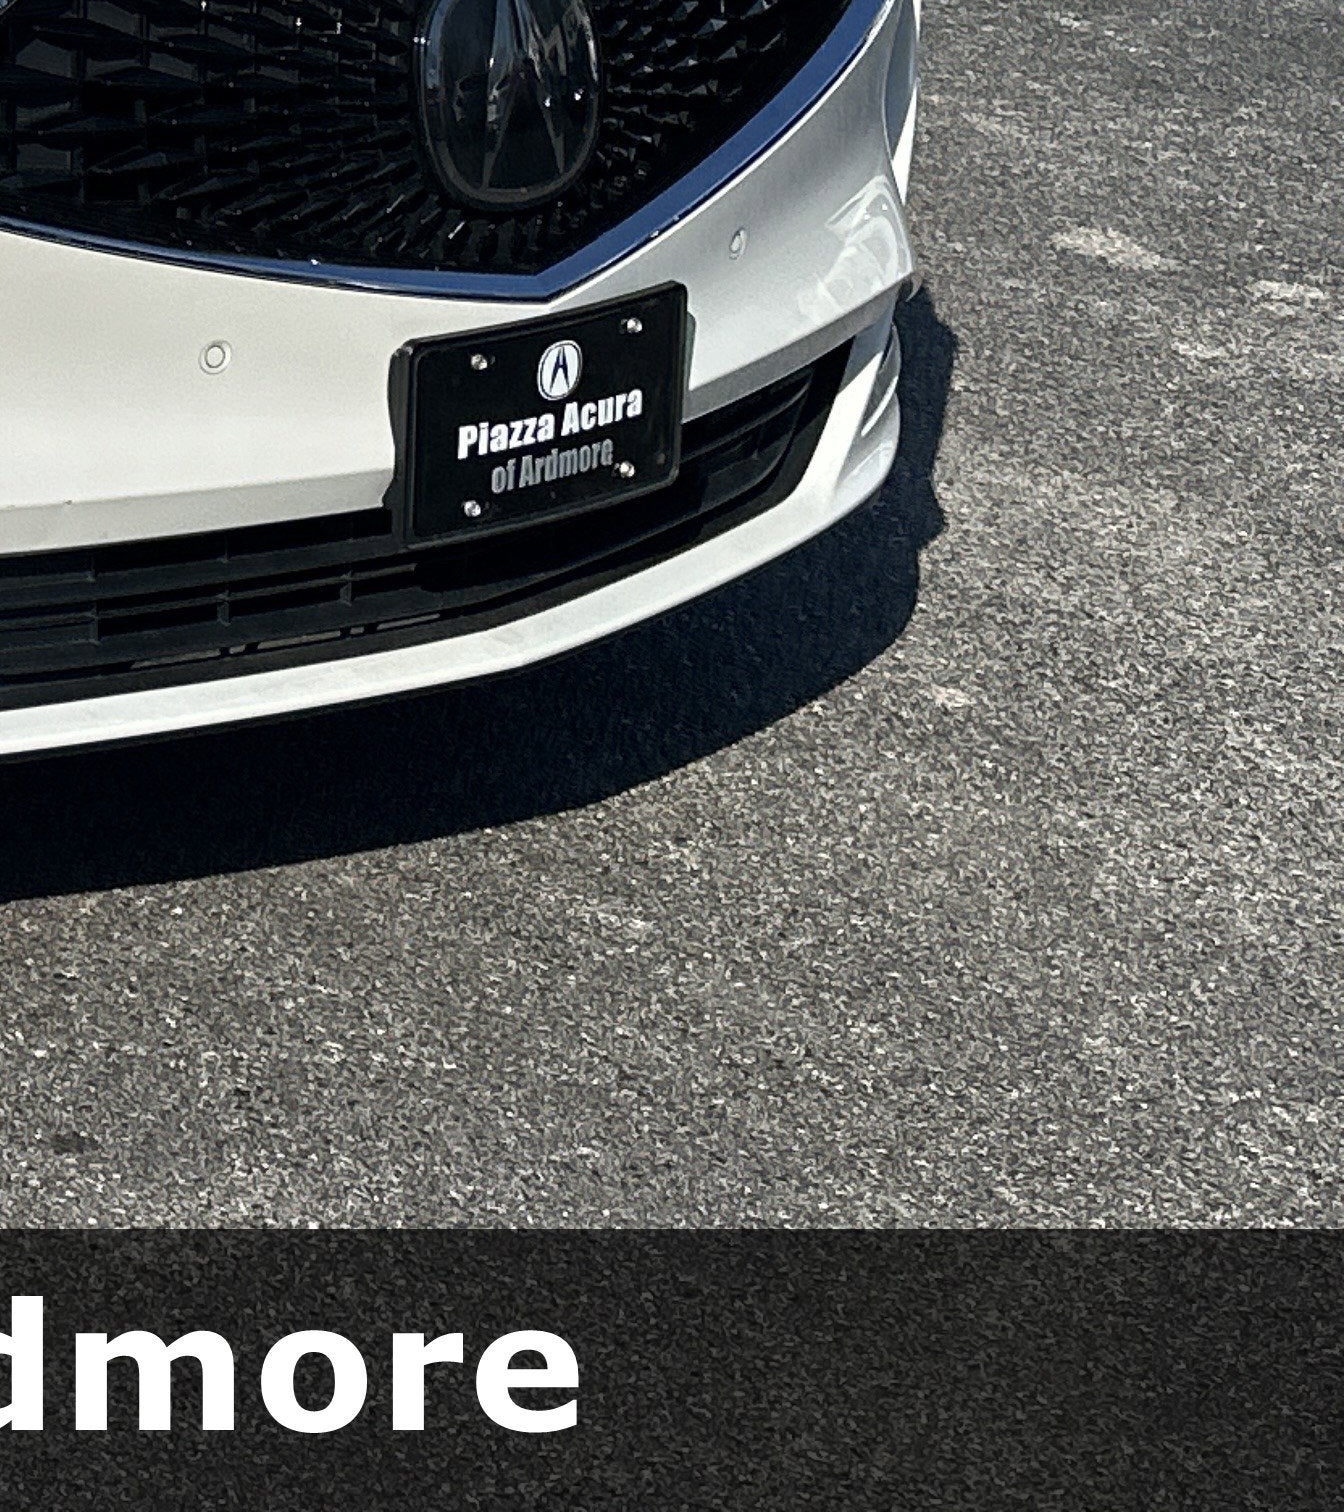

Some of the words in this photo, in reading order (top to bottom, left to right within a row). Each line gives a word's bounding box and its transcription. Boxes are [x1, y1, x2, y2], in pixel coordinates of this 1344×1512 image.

[457, 412, 556, 461] Piazza
[560, 388, 643, 437] Acura
[491, 456, 517, 495] of
[518, 438, 614, 489] Ardmore
